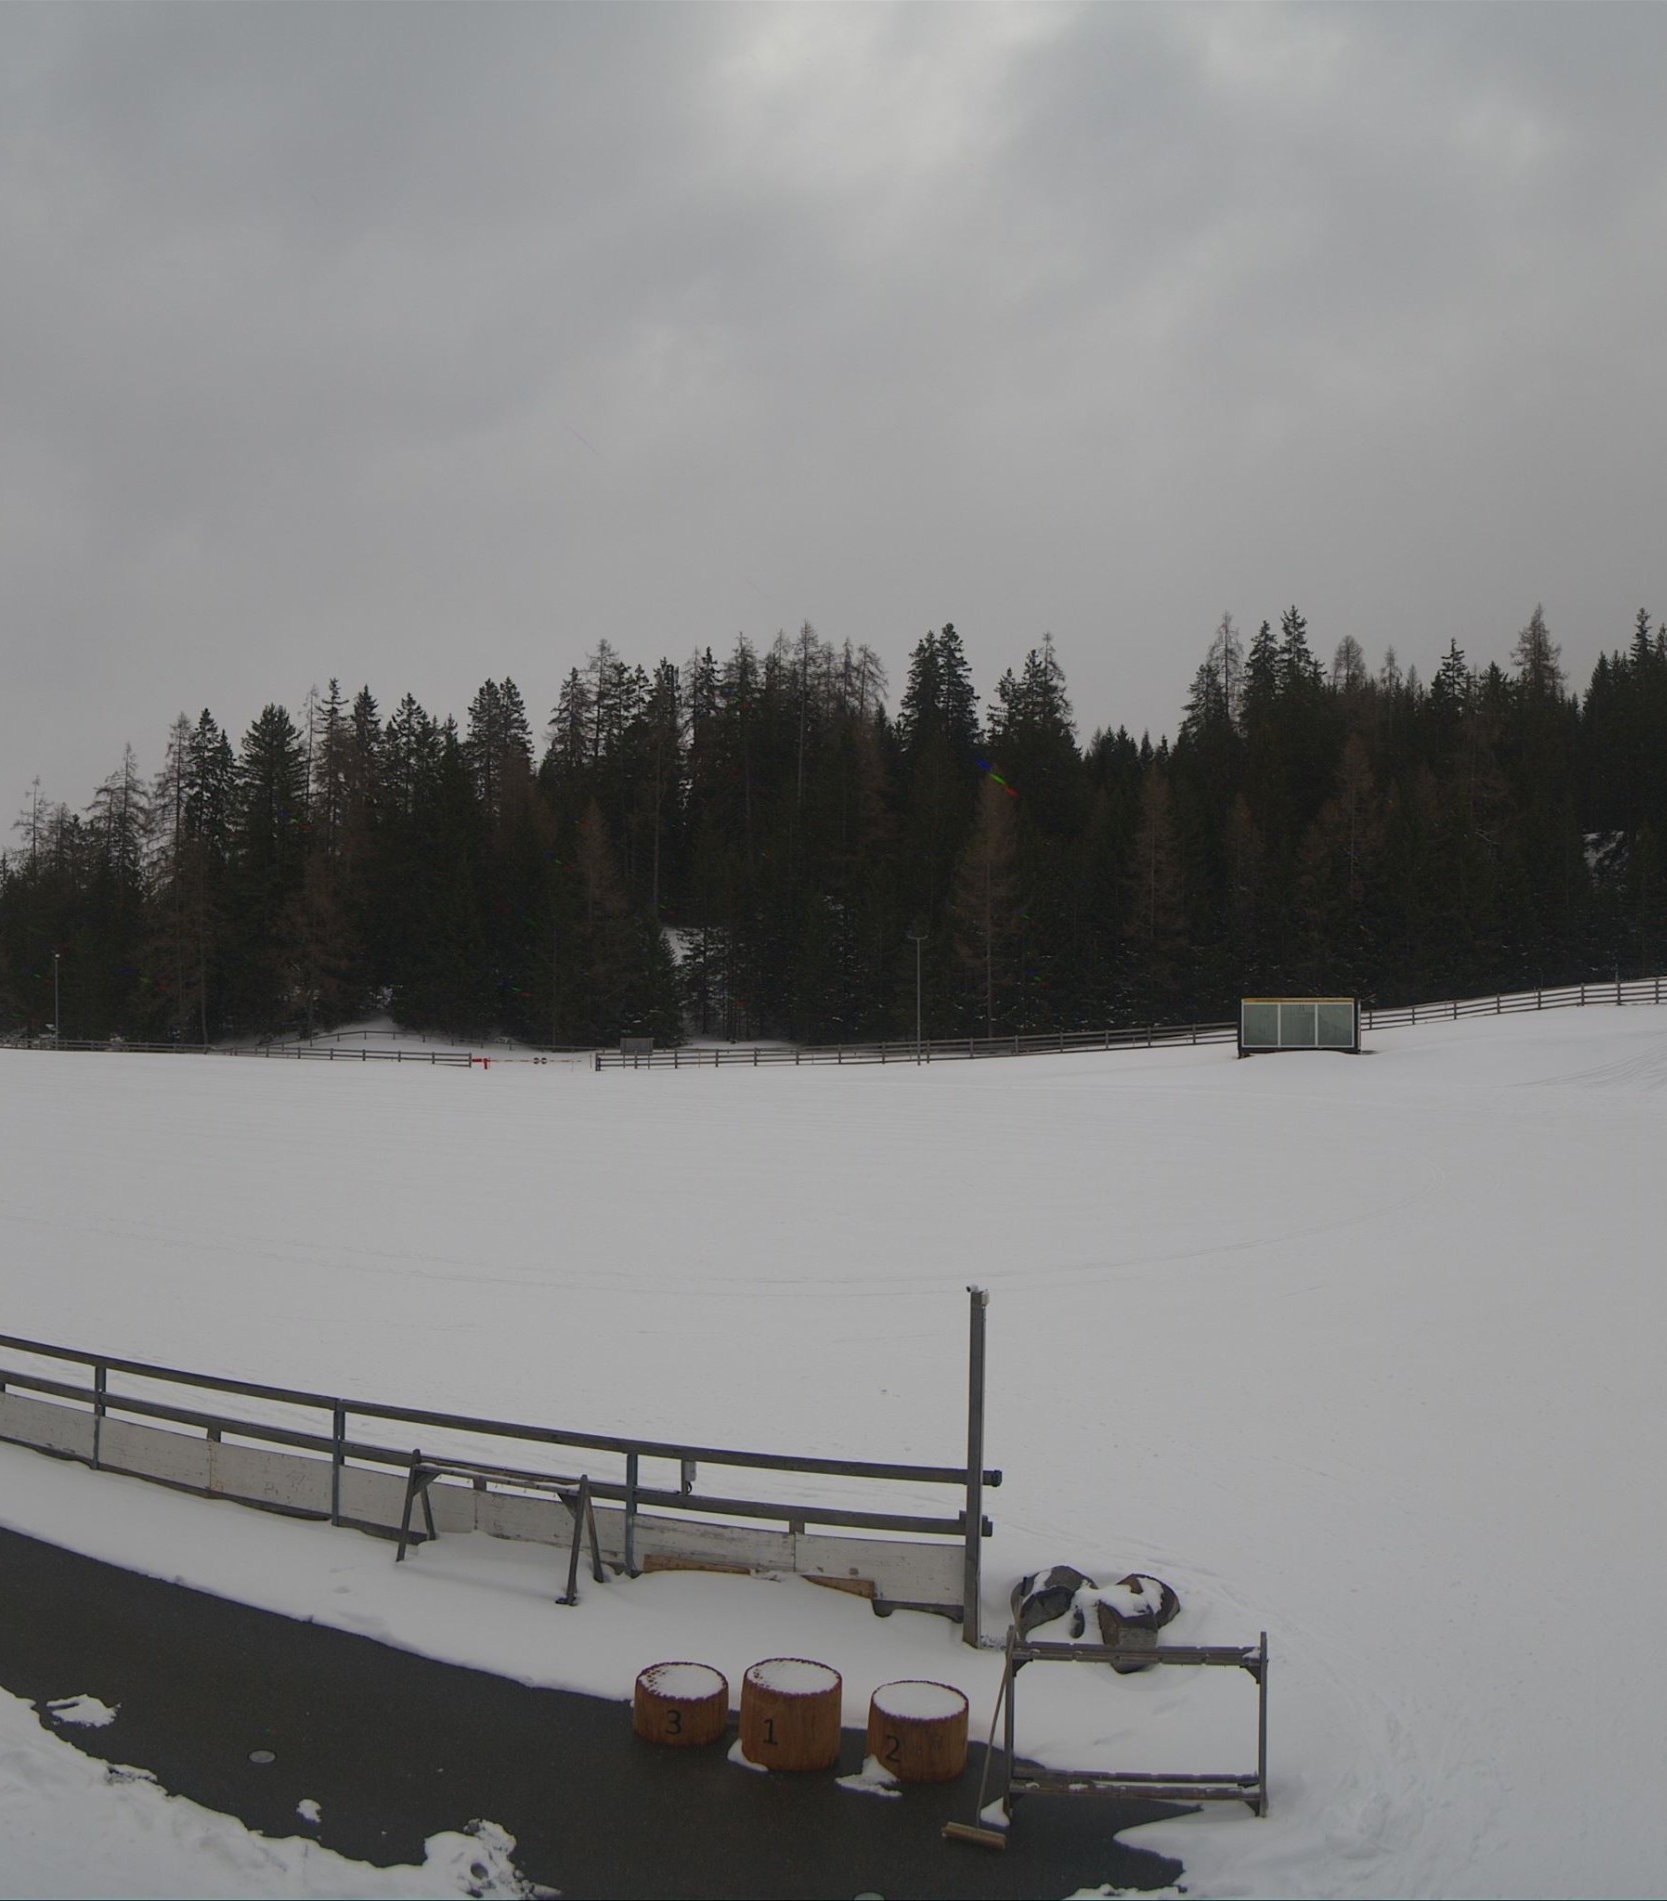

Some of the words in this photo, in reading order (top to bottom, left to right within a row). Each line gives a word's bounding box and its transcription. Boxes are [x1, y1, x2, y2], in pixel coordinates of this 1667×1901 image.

[665, 1709, 682, 1735] 3
[763, 1718, 779, 1746] 1
[885, 1735, 901, 1762] 2
